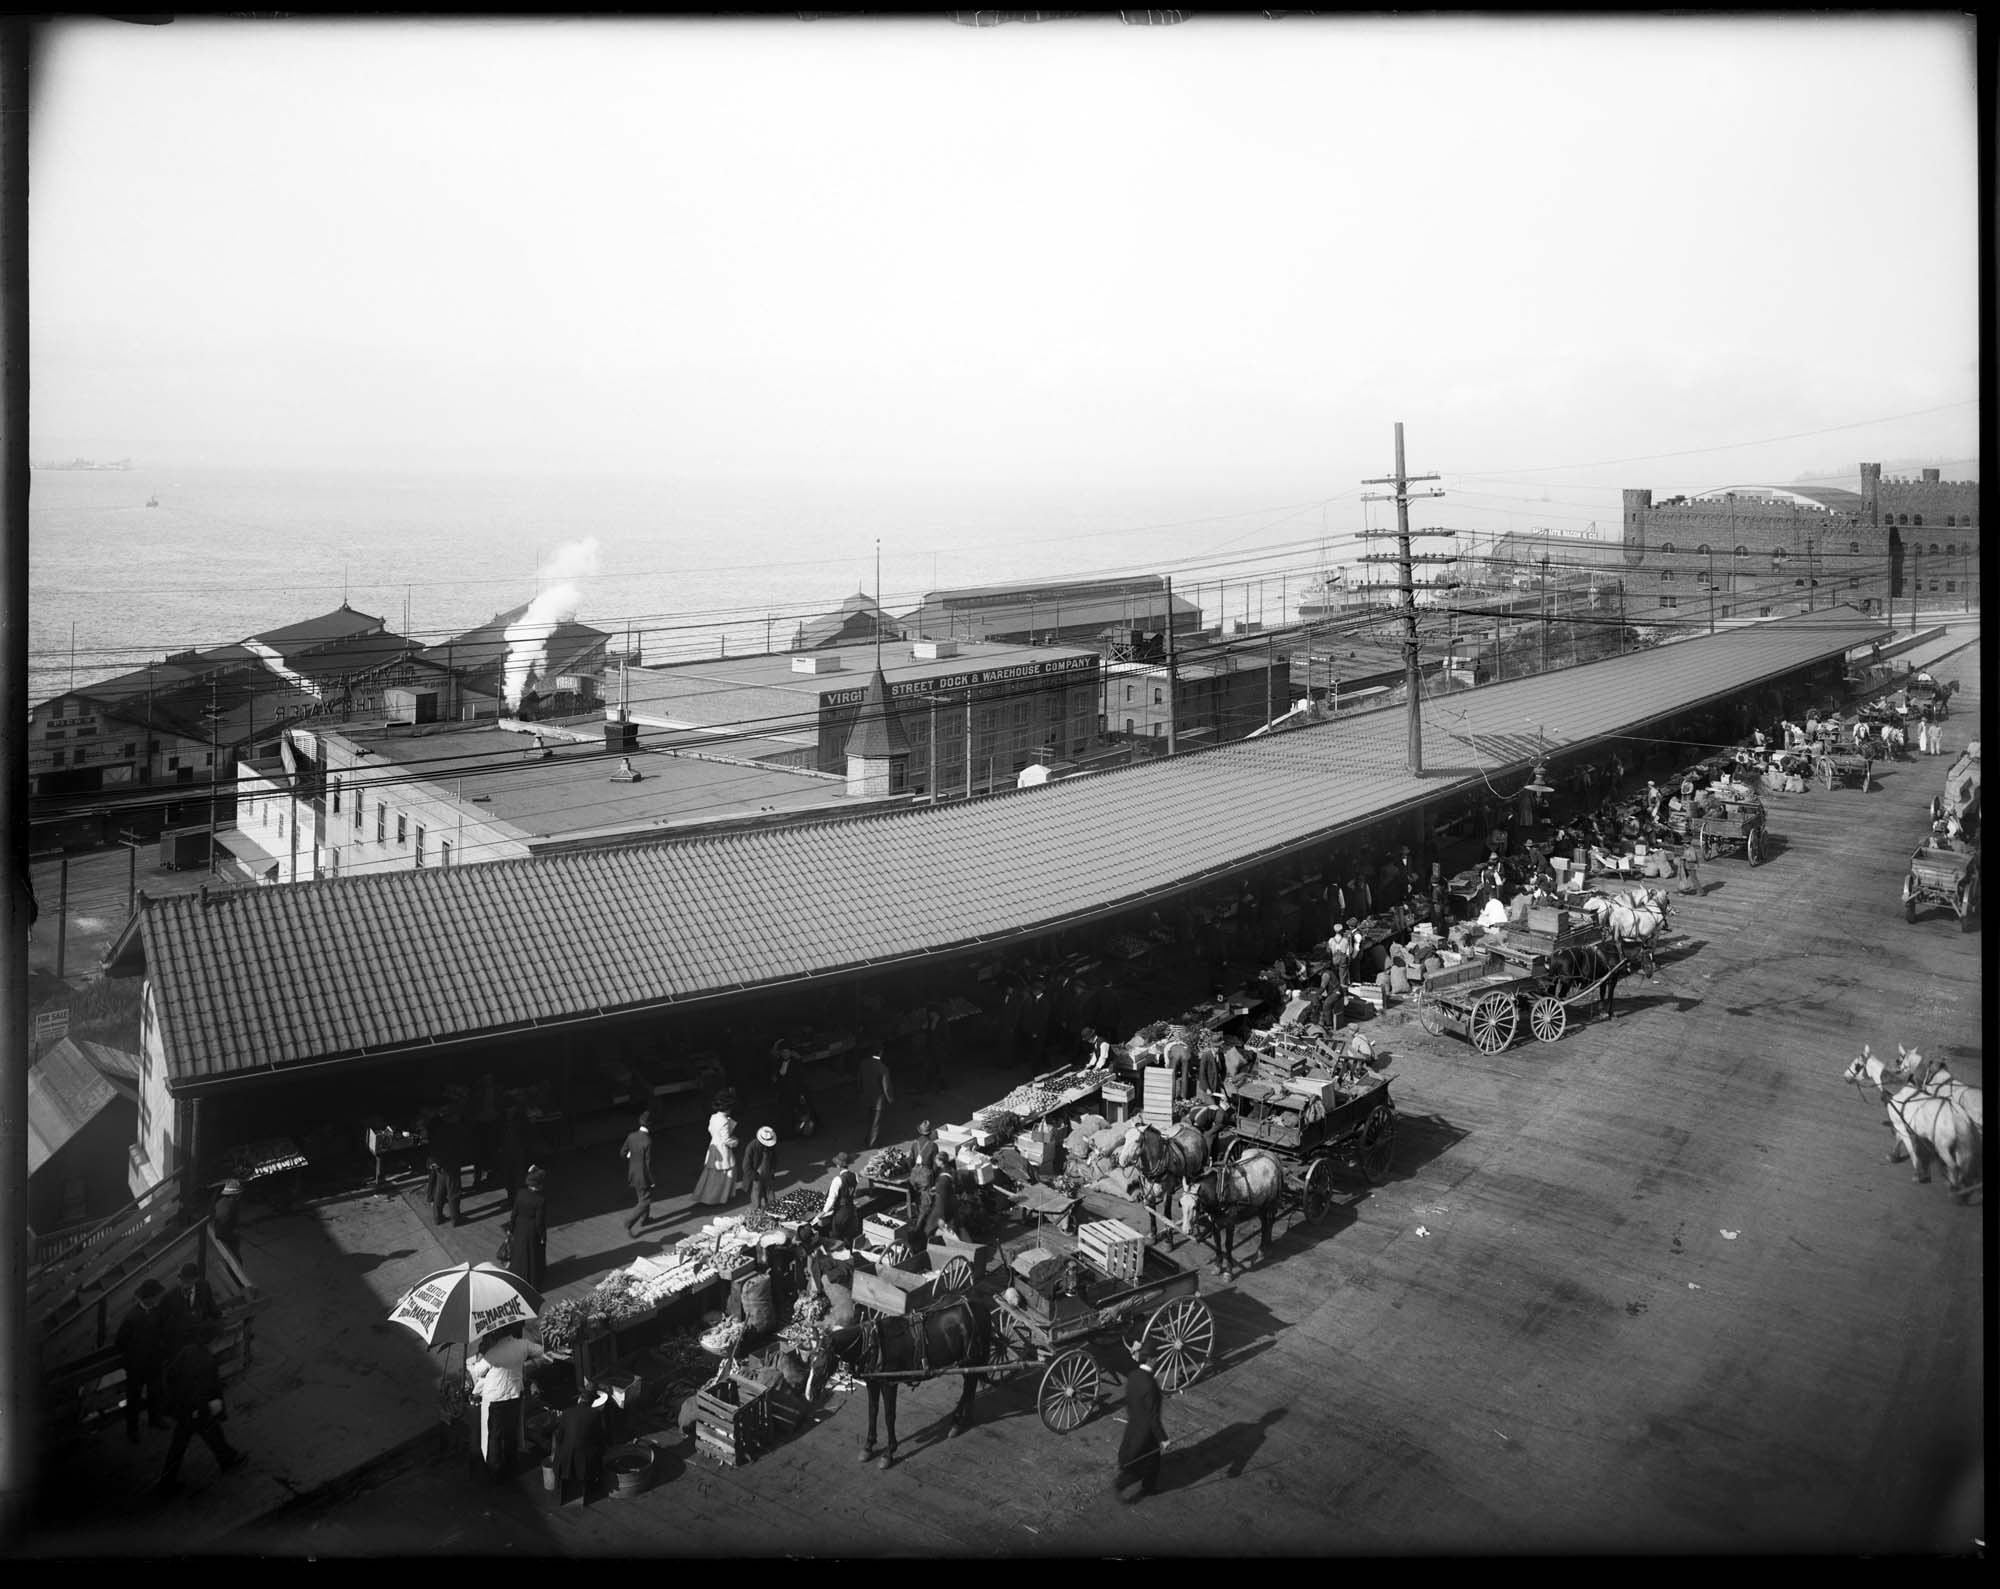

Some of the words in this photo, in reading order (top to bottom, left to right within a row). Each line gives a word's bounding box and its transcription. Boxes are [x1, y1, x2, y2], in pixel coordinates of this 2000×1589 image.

[891, 680, 934, 696] STREET
[939, 675, 968, 689] DOCK
[971, 674, 978, 683] &
[982, 664, 1041, 682] WAREHOUSE
[1045, 658, 1091, 672] COMPANY
[406, 1296, 416, 1309] THE
[471, 1311, 485, 1320] THE
[475, 1318, 488, 1334] BON
[485, 1294, 526, 1324] MARCHE
[398, 1308, 411, 1318] BON
[408, 1304, 440, 1335] MARCHE
